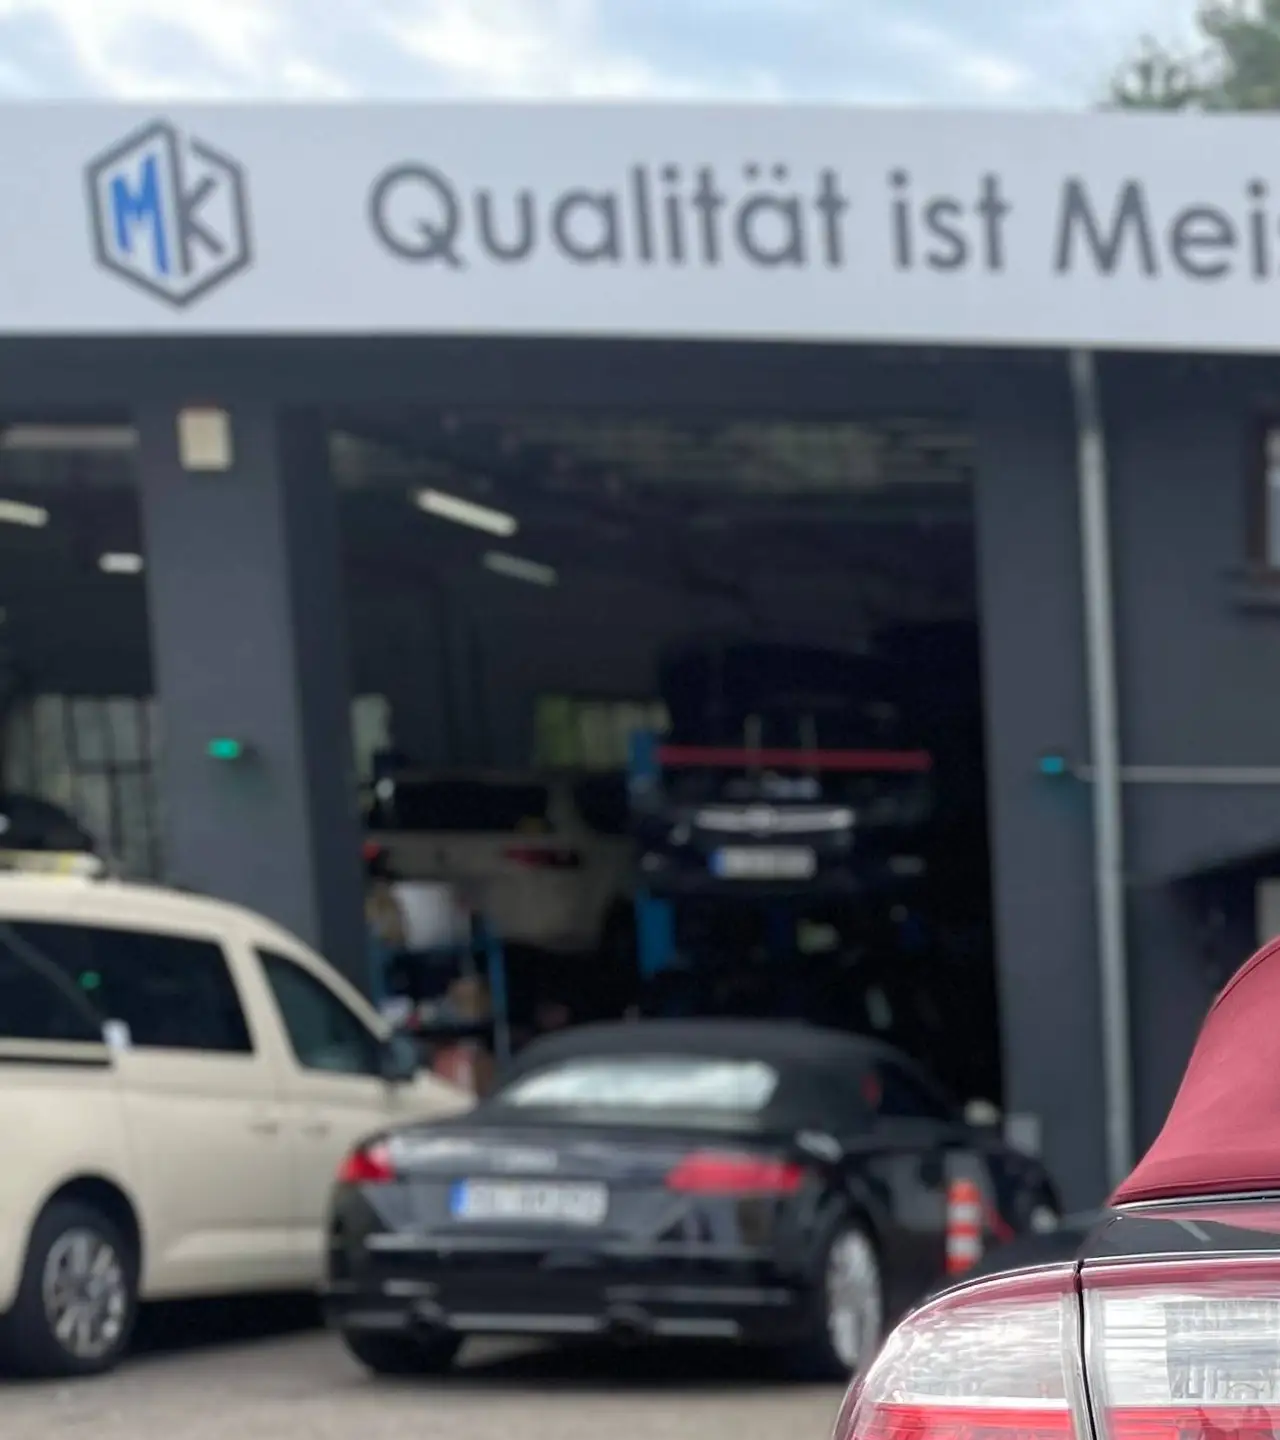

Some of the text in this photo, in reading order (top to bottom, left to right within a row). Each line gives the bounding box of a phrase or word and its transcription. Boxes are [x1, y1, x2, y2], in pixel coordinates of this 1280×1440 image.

[108, 124, 226, 277] MK
[367, 160, 850, 270] Qualität
[888, 168, 1011, 273] ist
